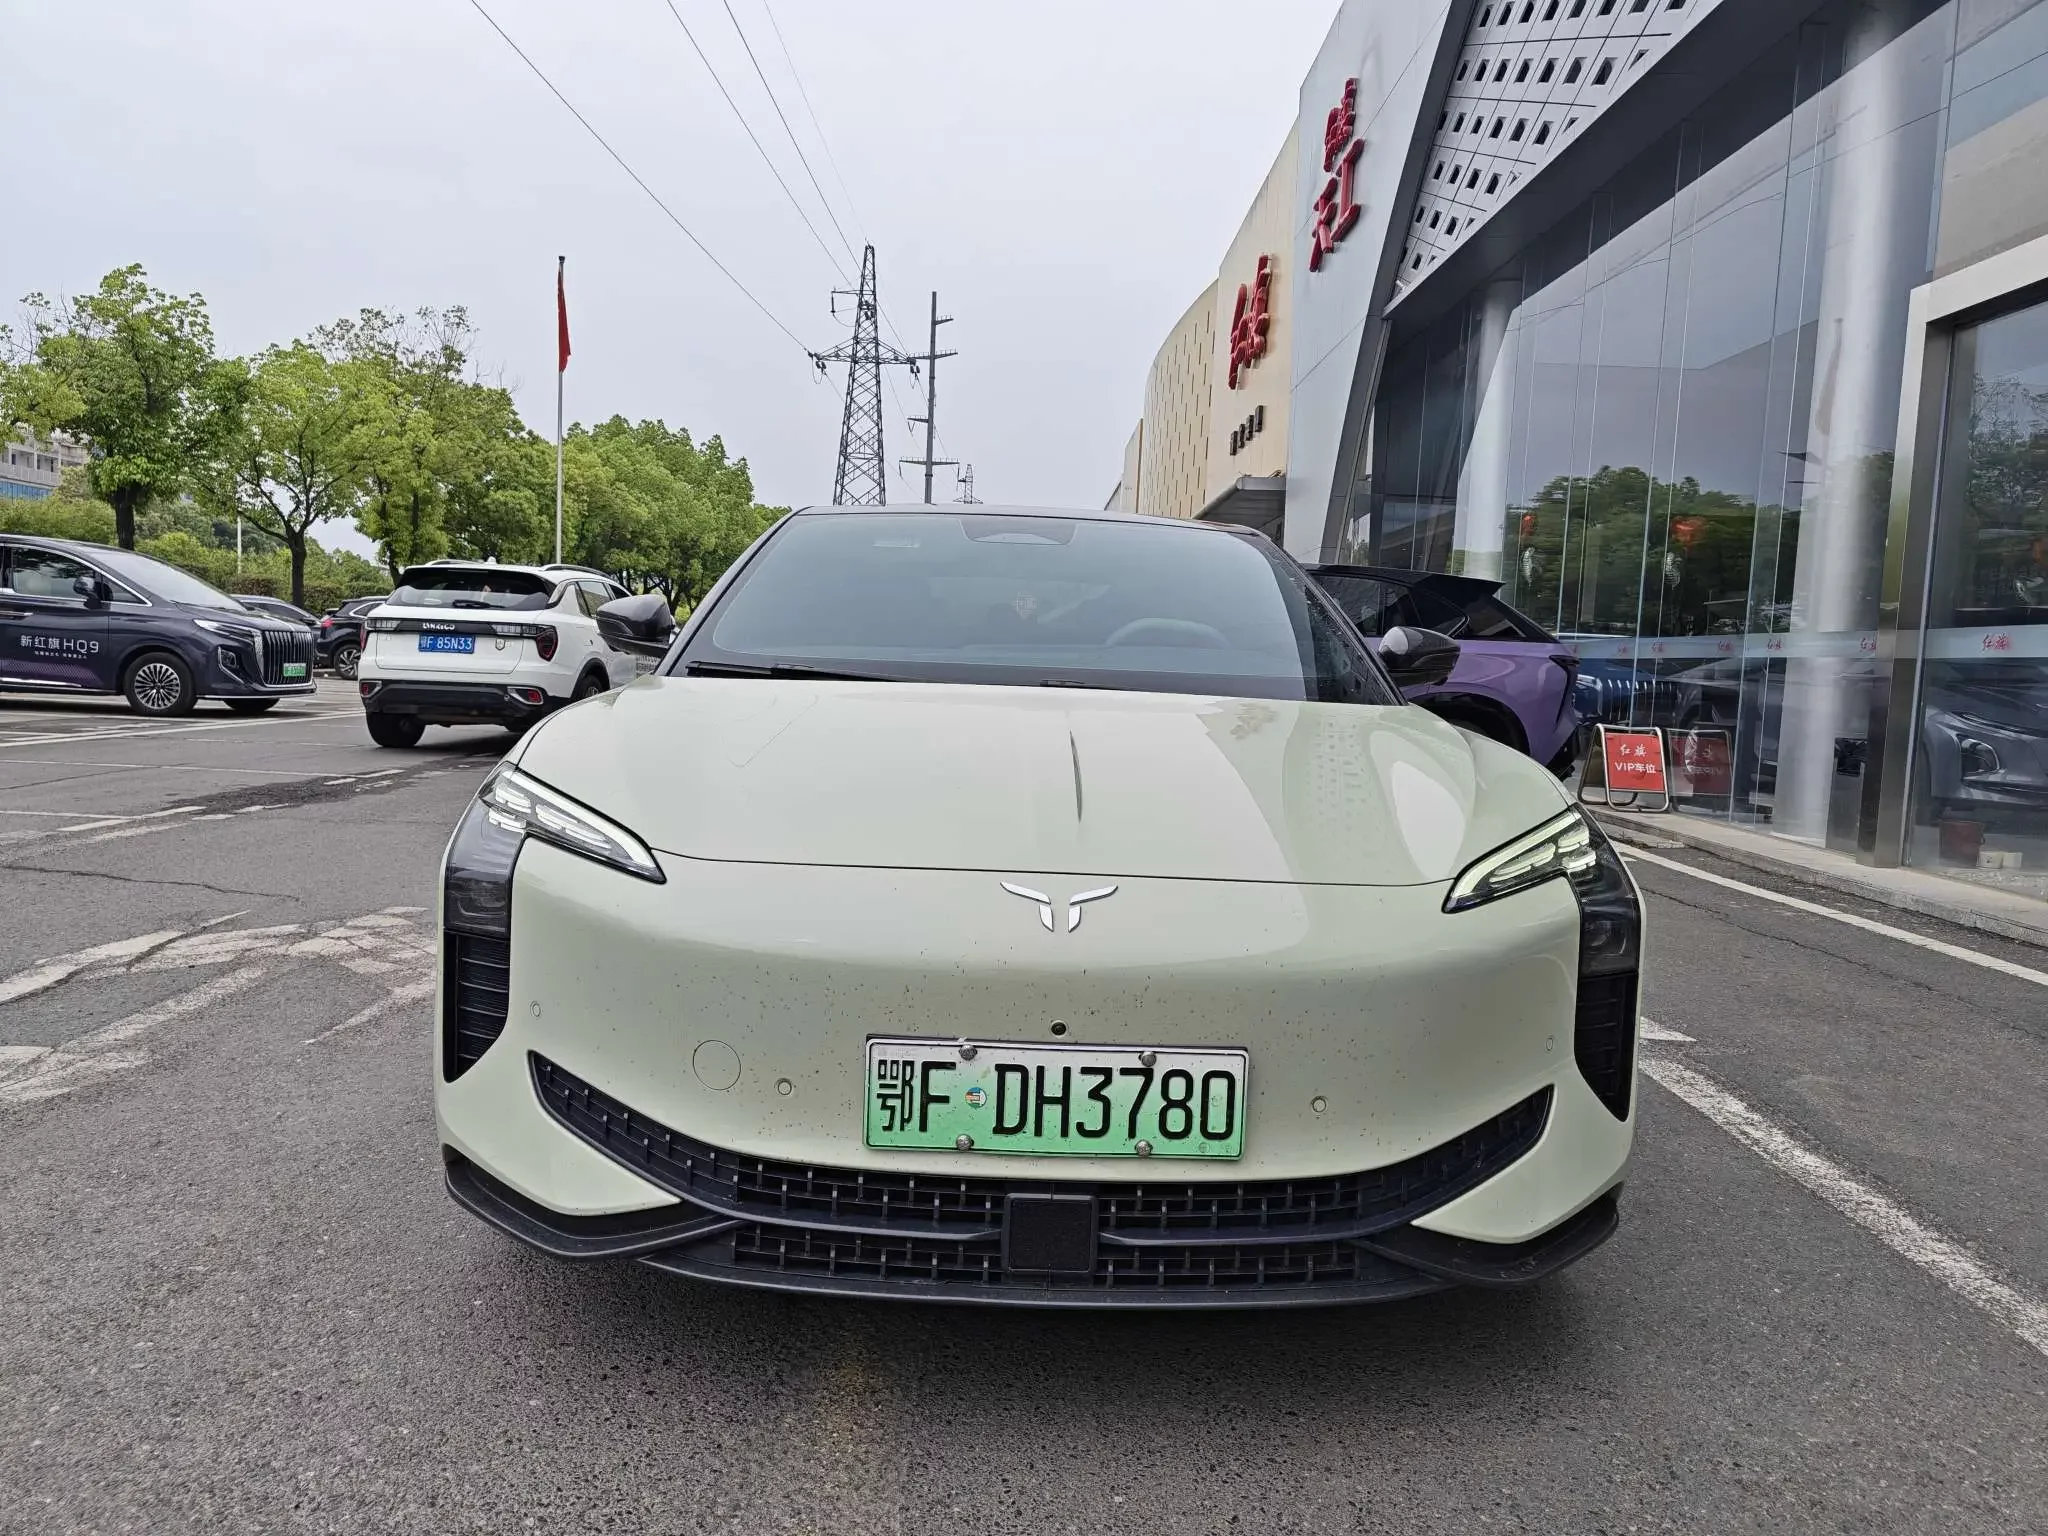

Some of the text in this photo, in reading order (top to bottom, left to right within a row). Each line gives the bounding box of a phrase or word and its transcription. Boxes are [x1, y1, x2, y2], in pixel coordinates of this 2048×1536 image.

[437, 636, 473, 650] 85N33
[1620, 743, 1648, 757] 红旗
[1615, 762, 1656, 774] VIP车位
[876, 1059, 1236, 1141] 鄂F DH3780
